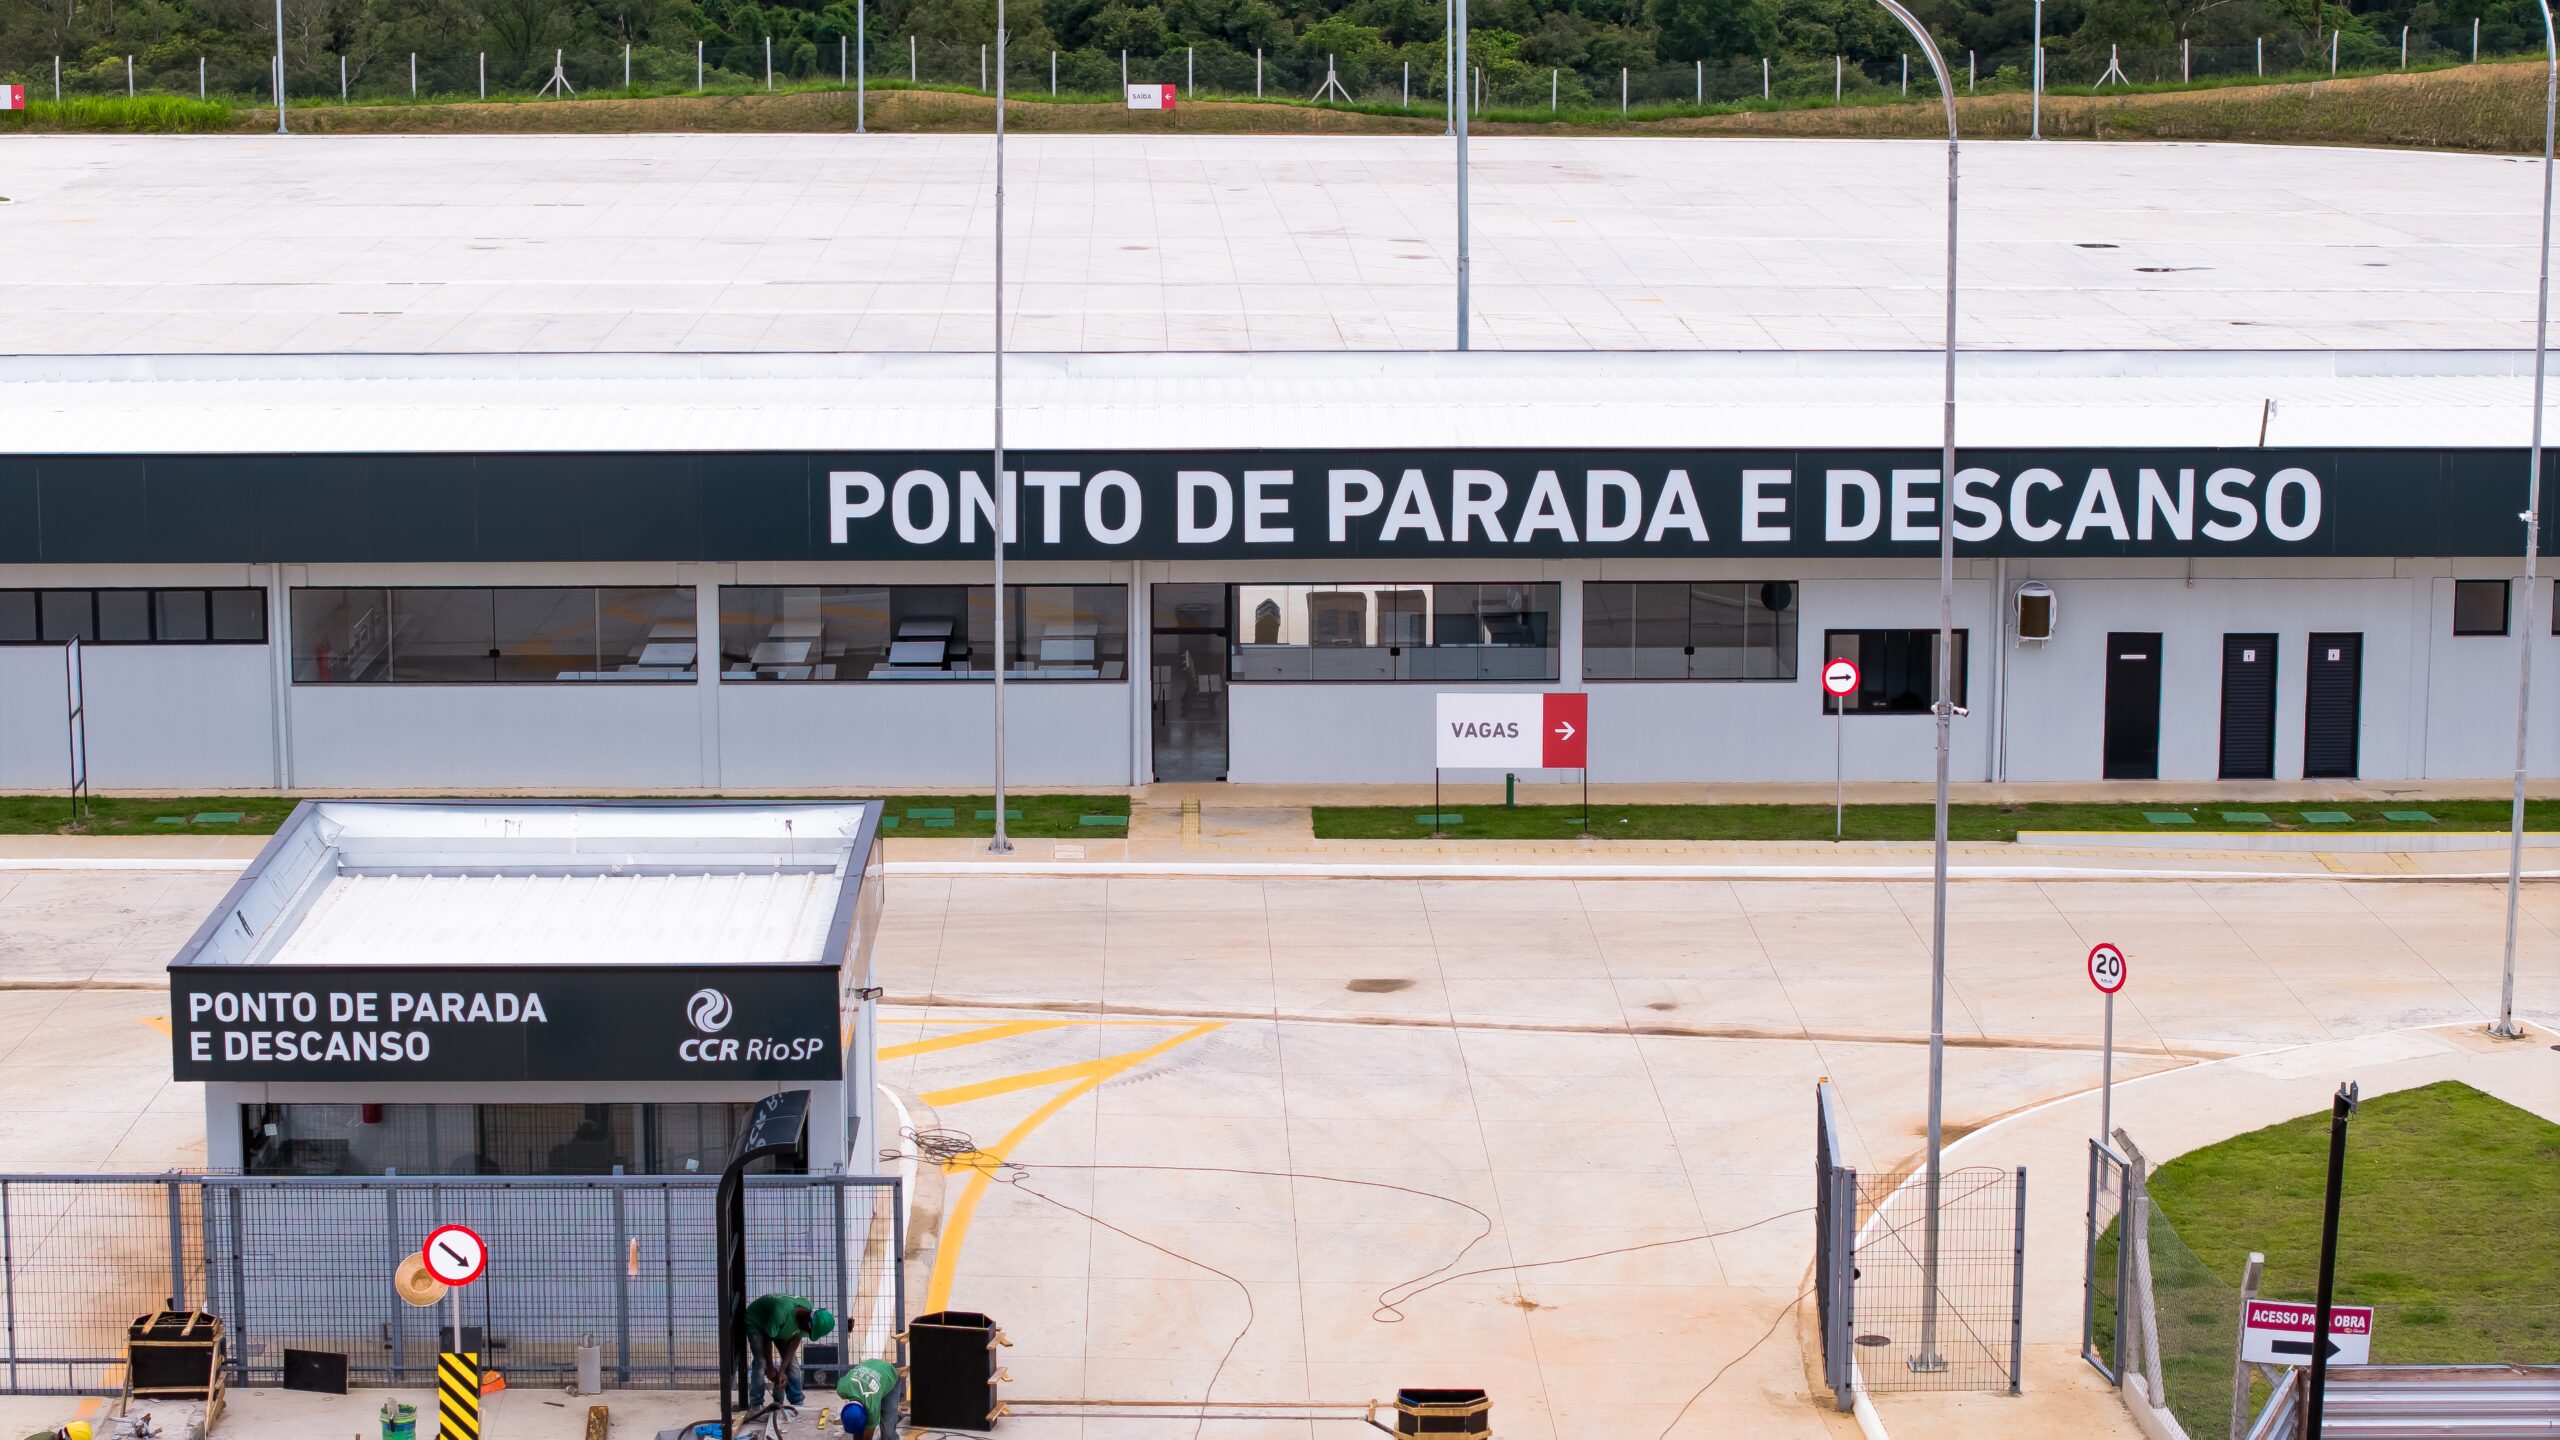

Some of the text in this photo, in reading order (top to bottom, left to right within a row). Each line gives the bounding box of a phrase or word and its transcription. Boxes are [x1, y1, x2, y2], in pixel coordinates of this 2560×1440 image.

[830, 467, 2322, 544] PONTO DE PARADA E DESCANSO
[1451, 722, 1519, 739] VAGAS
[2096, 953, 2120, 977] 20
[189, 992, 548, 1023] PONTO DE PARADA
[190, 1031, 430, 1062] E DESCANSO
[679, 1037, 824, 1062] CCR RioSP
[2252, 1309, 2299, 1325] ACESSO
[2334, 1315, 2366, 1328] OBRA
